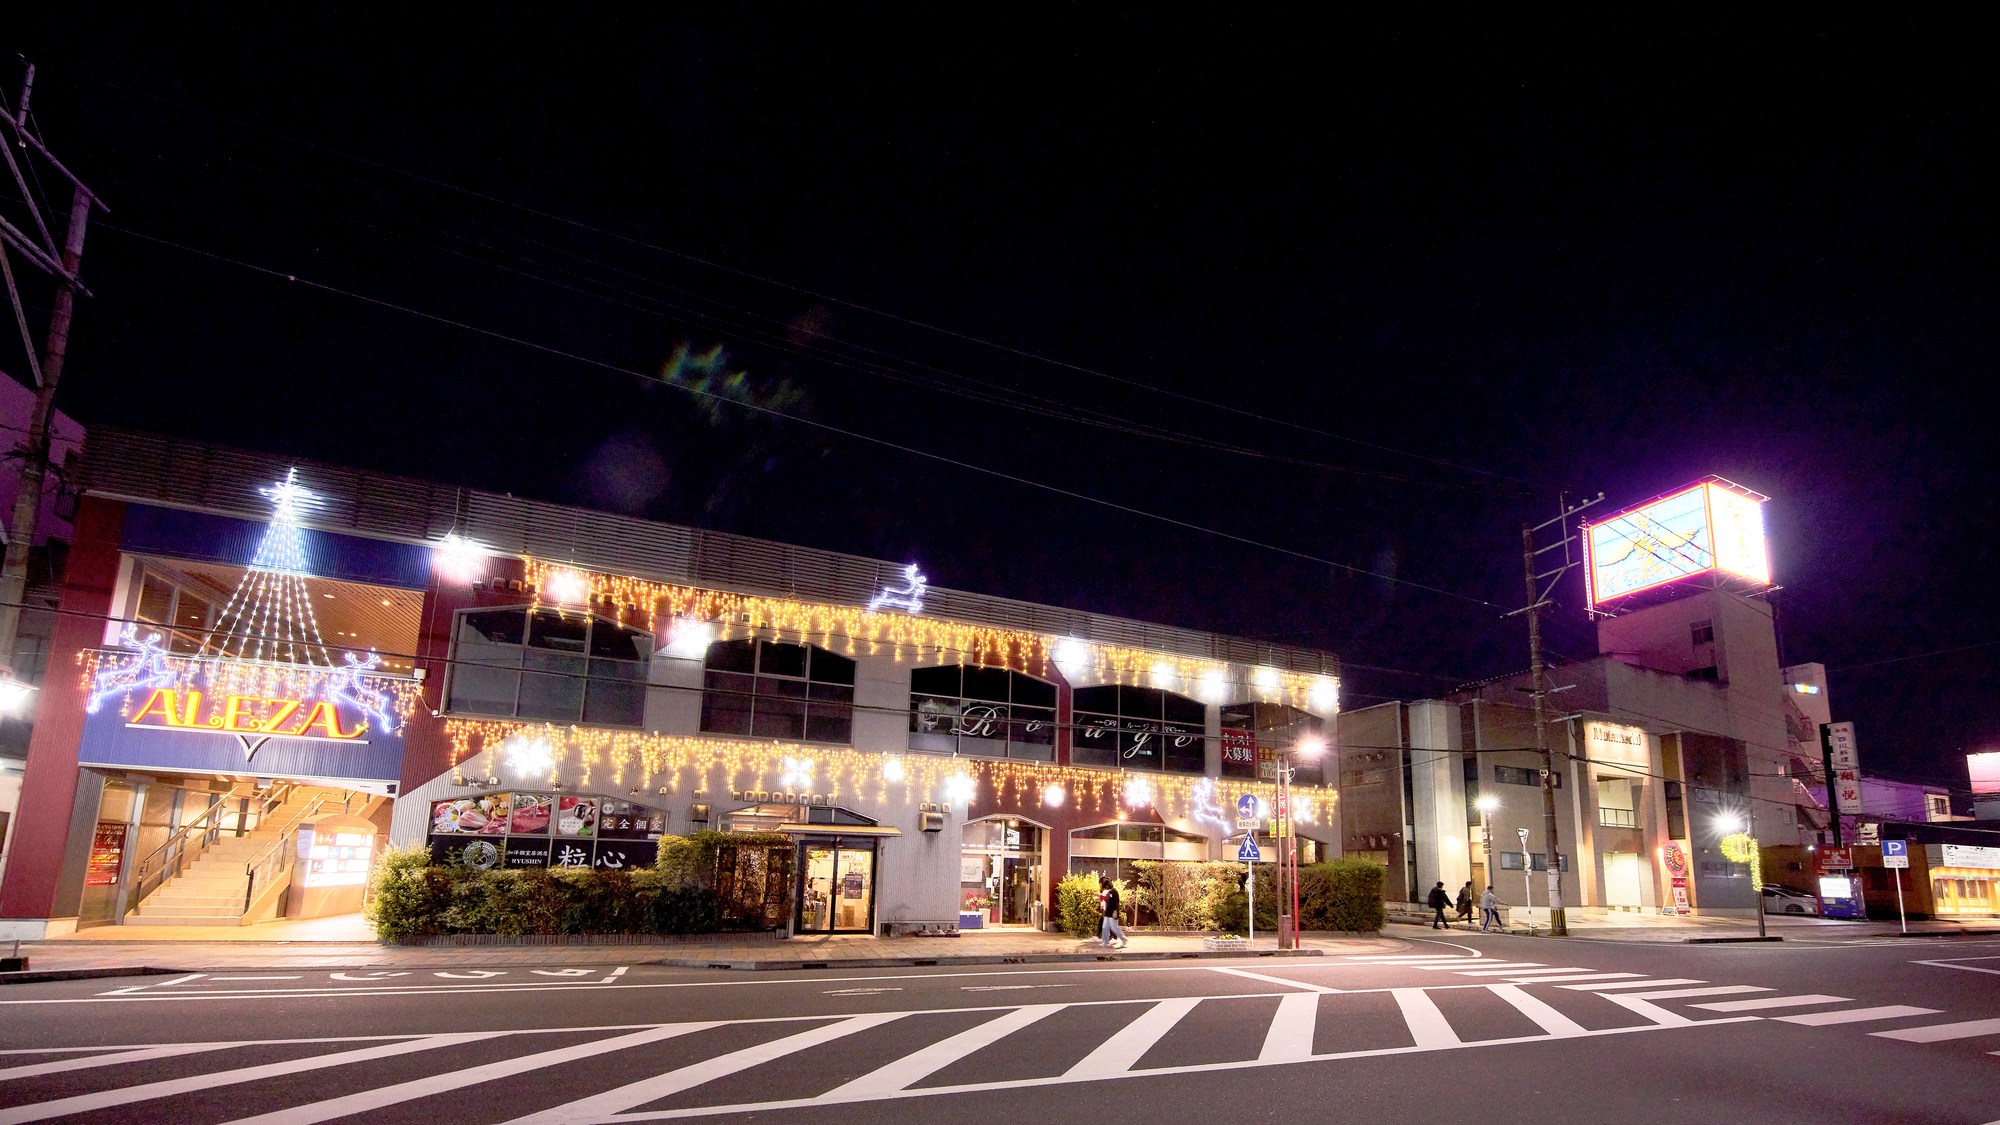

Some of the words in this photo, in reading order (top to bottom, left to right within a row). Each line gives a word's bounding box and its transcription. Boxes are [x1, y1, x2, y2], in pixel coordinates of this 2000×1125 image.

[131, 688, 368, 740] ALEZA
[1223, 731, 1253, 746] キャスト
[1223, 746, 1253, 762] 大募集
[602, 818, 663, 831] 完全個室
[1888, 842, 1902, 854] P
[558, 844, 626, 869] 粒心
[208, 968, 598, 981] タクシー
